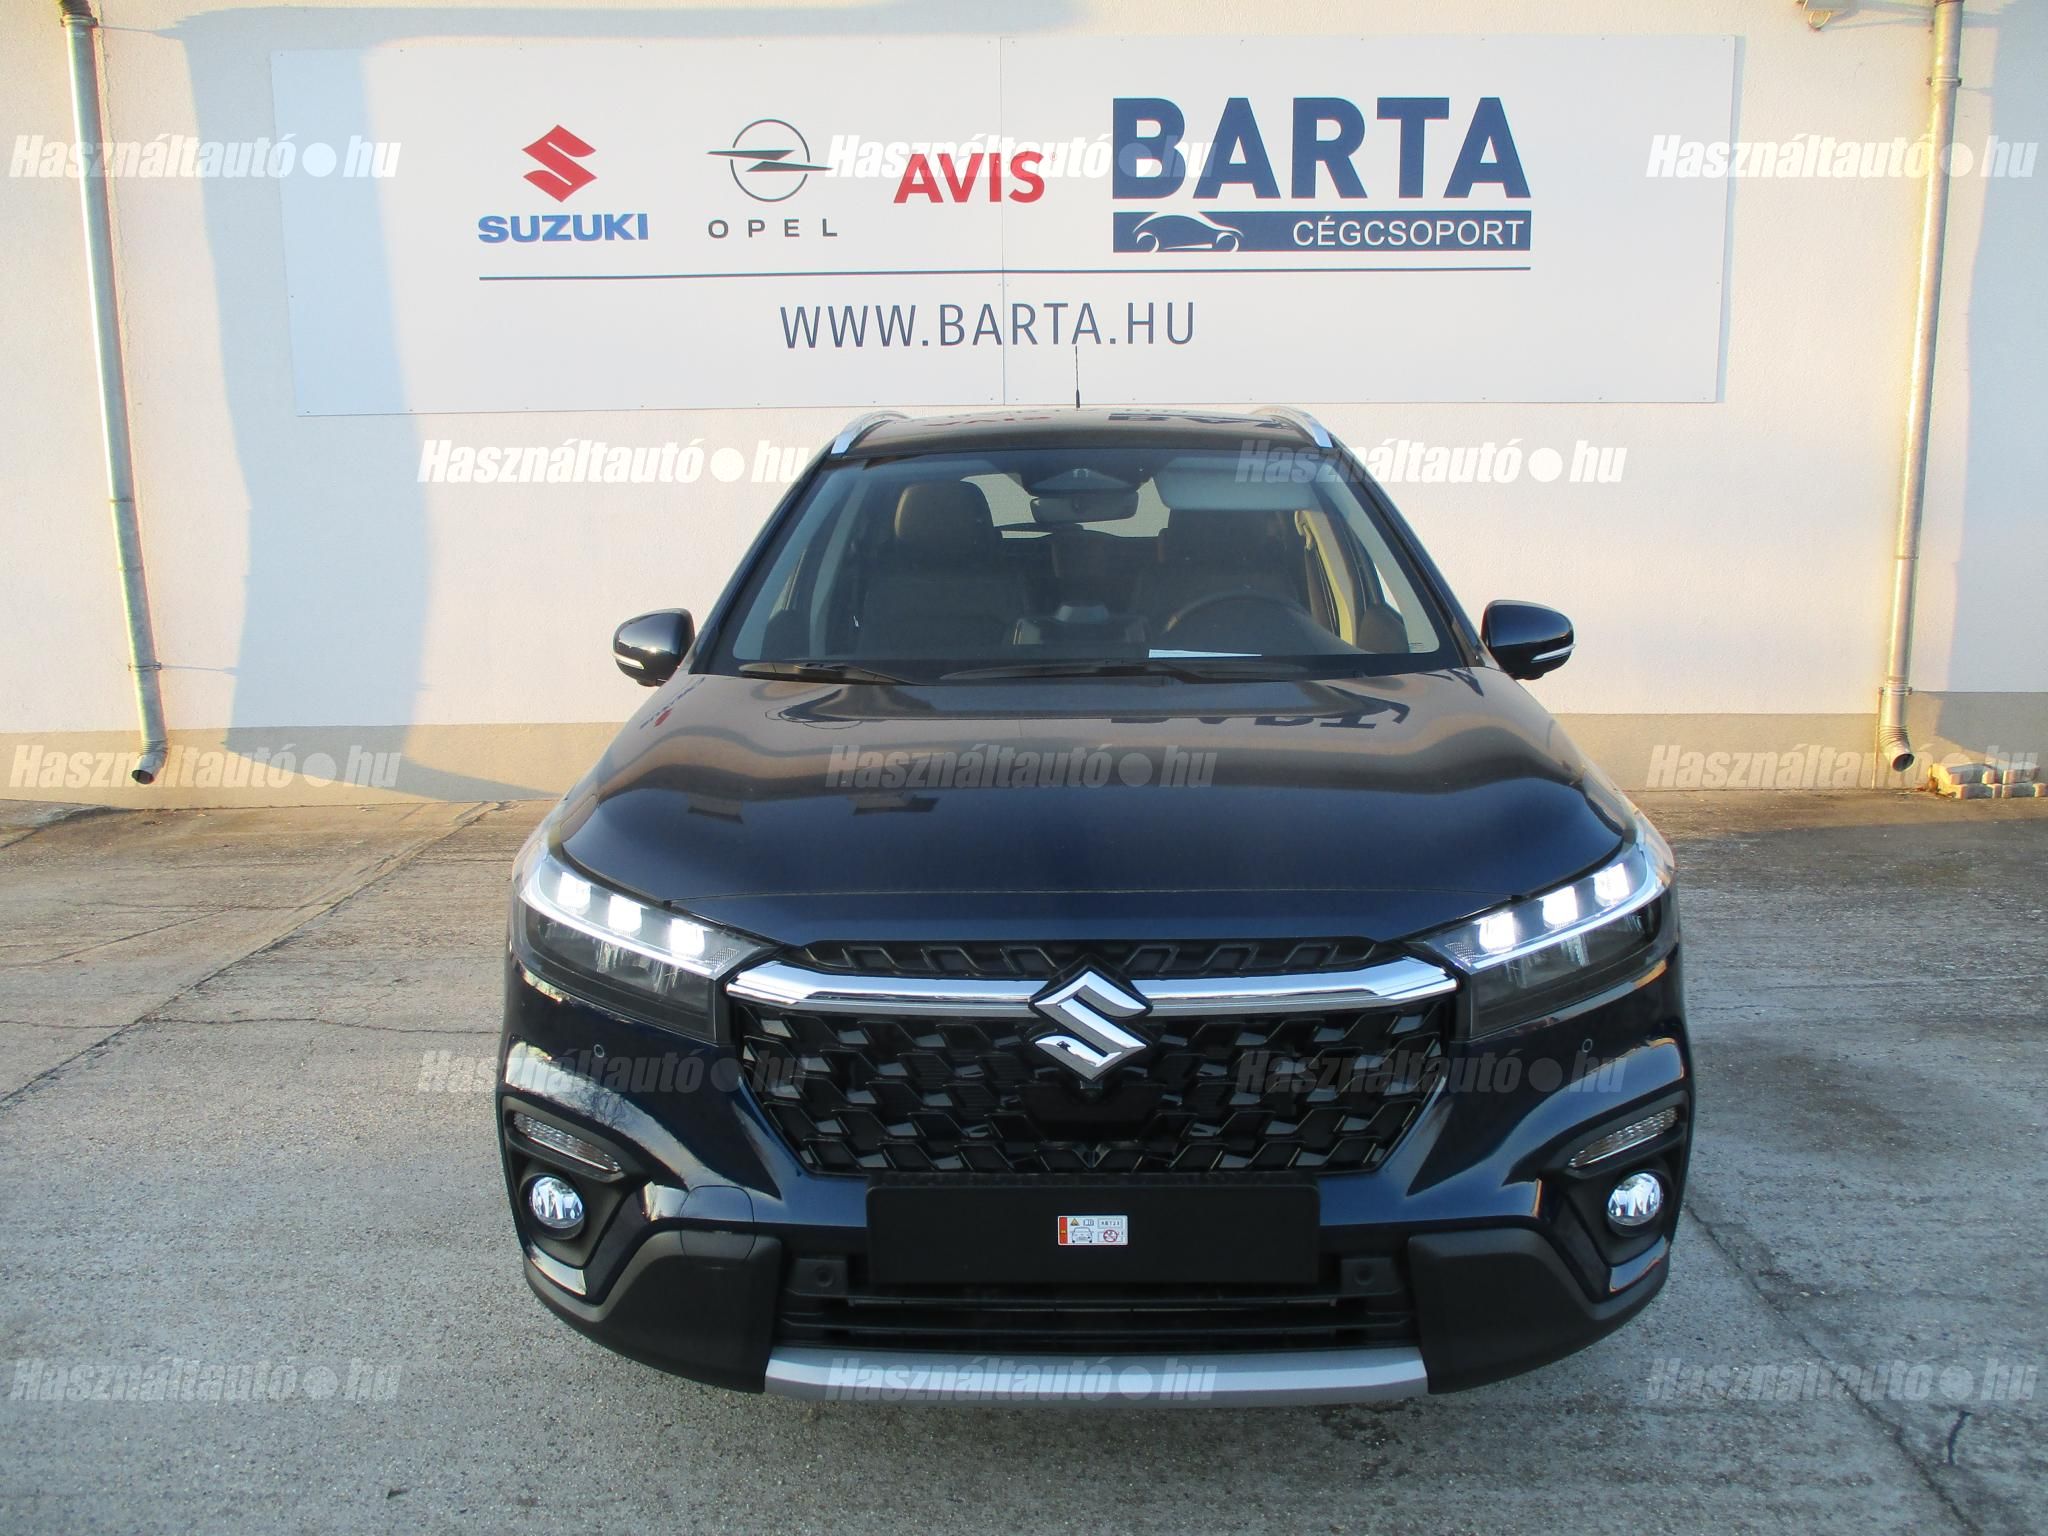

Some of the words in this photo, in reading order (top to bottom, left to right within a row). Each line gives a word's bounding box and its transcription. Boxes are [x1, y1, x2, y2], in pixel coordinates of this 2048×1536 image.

[1113, 97, 1532, 200] BARTA
[893, 151, 1046, 204] AVIS
[478, 213, 649, 243] SUZUKI
[708, 218, 839, 239] OPEL
[1292, 215, 1526, 247] CÉGCSOPORT
[780, 302, 1195, 349] WWW.BARTA.HU
